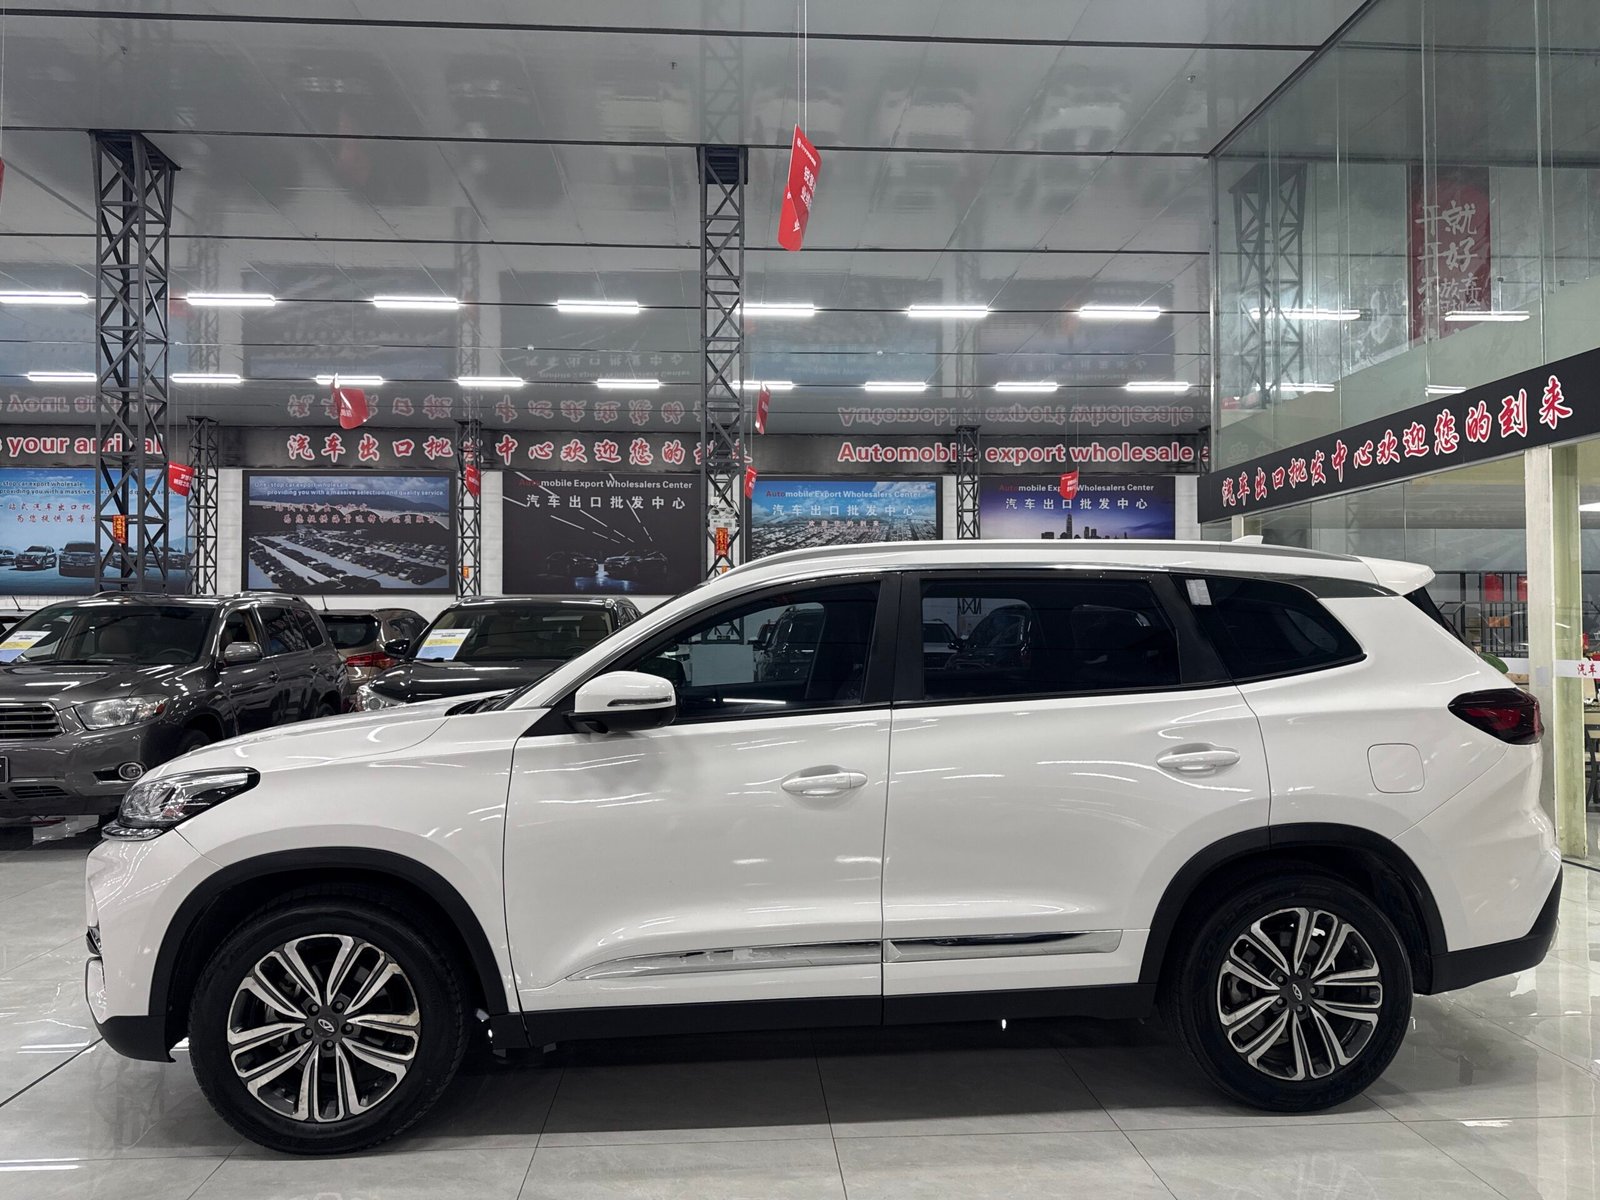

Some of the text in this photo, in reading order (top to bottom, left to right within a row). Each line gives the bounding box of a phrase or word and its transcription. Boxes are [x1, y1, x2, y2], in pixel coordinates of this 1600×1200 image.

[7, 436, 70, 457] your
[1221, 374, 1573, 507] 汽车出口批发中心欢迎您的到来
[985, 444, 1066, 466] export
[1070, 442, 1194, 462] wholesale
[573, 479, 604, 489] Export
[606, 480, 661, 489] Wholesalers
[662, 480, 692, 489] Center
[1076, 484, 1125, 492] Wholesalers
[1127, 484, 1154, 492] Center
[814, 489, 842, 499] Export
[843, 489, 893, 498] Wholesalers
[526, 494, 685, 509] 汽车出口批发中心
[1006, 498, 1148, 510] 汽车出口批发中心
[772, 503, 915, 517] 汽车出口批发中心
